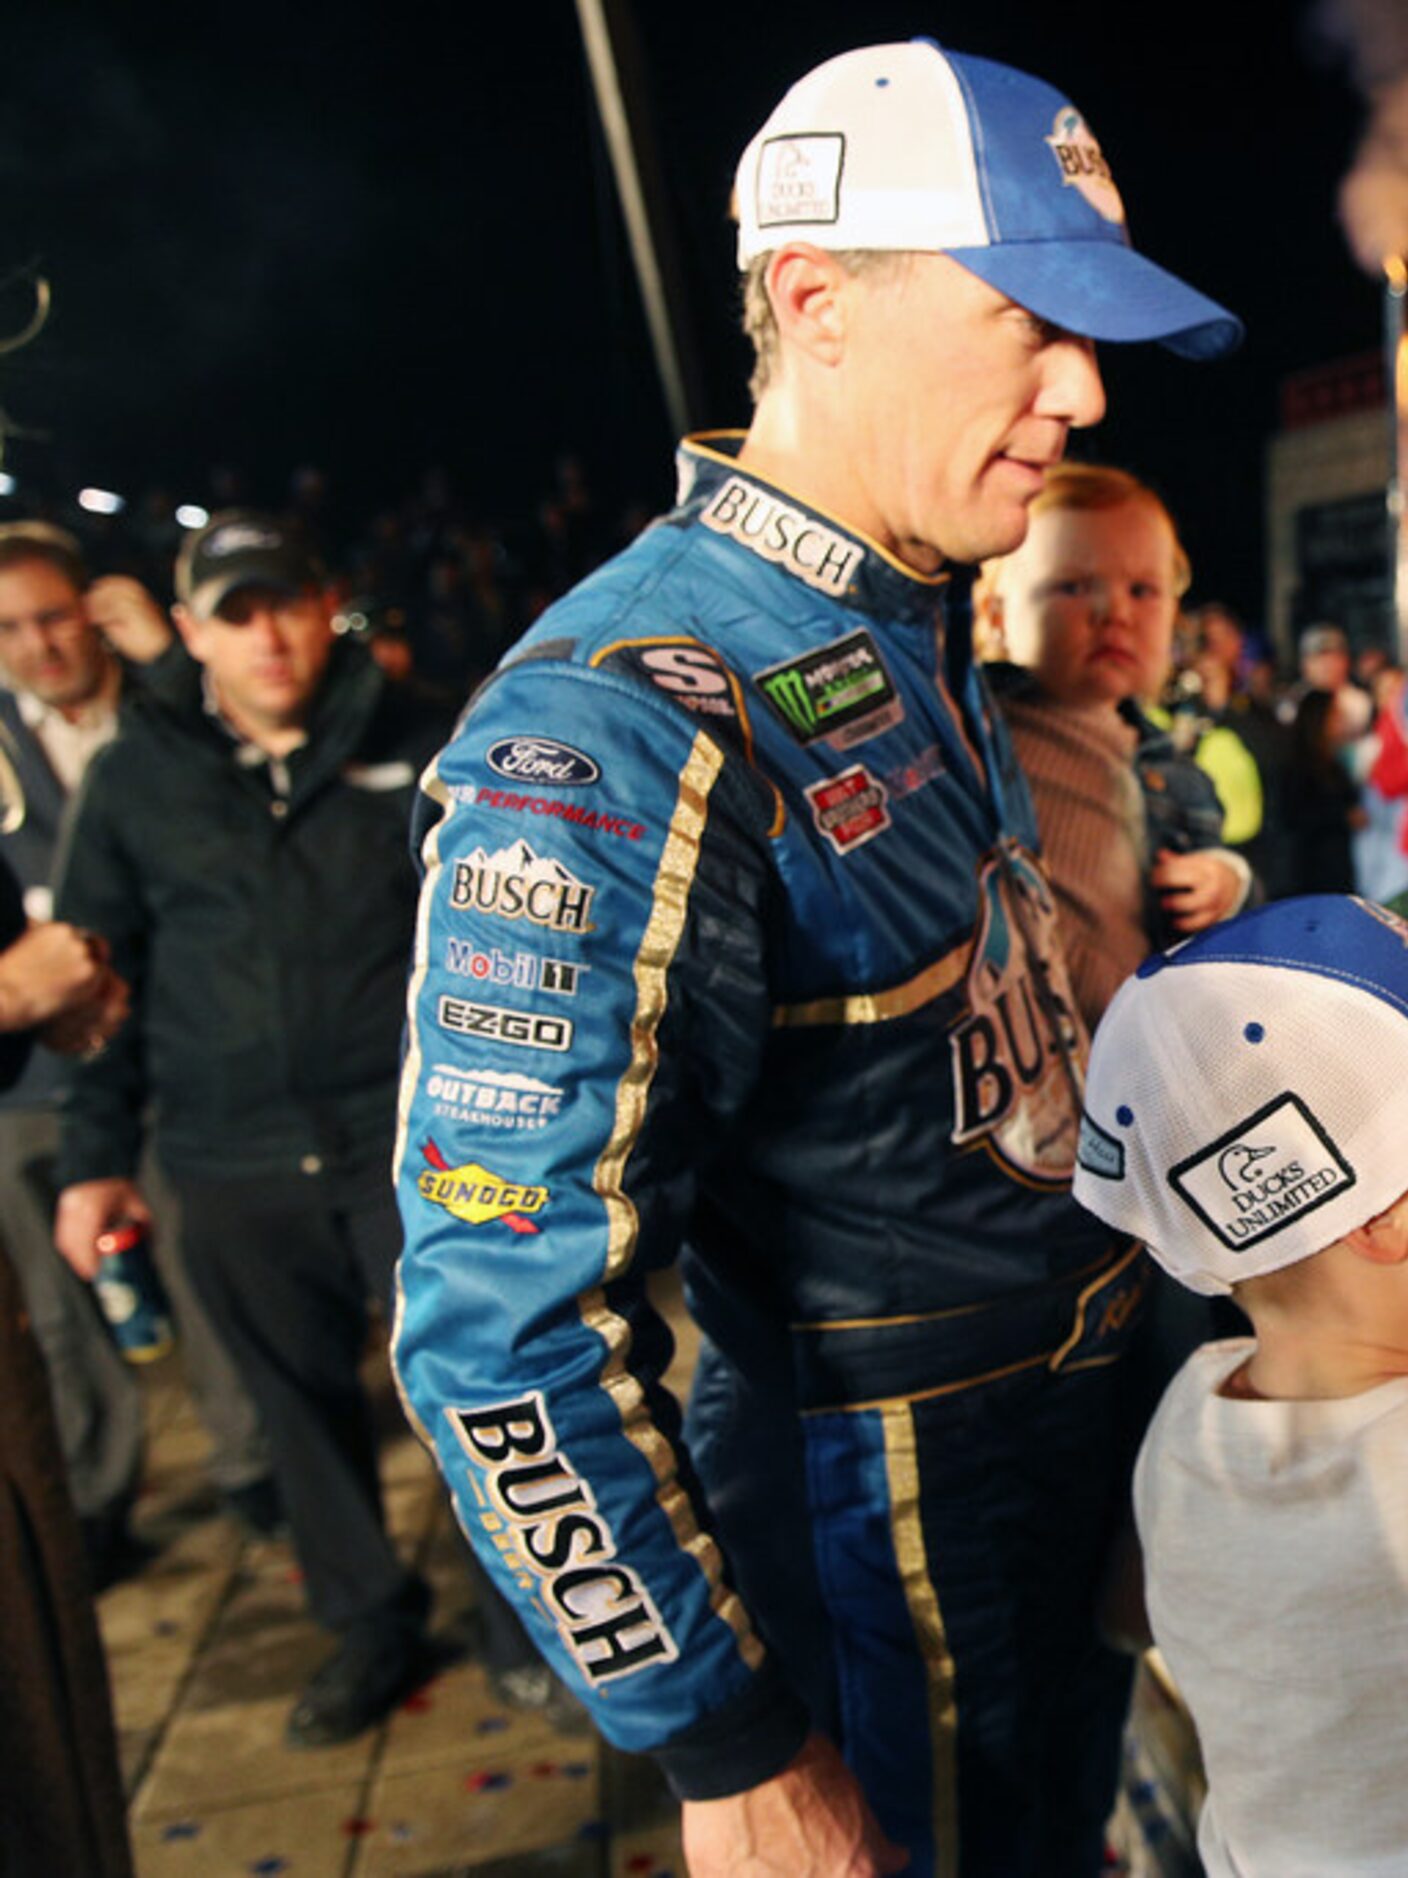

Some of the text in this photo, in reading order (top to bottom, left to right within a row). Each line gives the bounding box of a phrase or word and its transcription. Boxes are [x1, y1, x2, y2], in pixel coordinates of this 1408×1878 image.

[711, 482, 855, 586] BUSCH
[501, 743, 579, 780] Ford
[474, 786, 649, 843] PERFORMANCE
[452, 861, 589, 929] BUSCH
[447, 939, 537, 989] Mobil
[426, 1076, 562, 1115] OUTBACK
[420, 1173, 541, 1209] SUNOCO
[1226, 1167, 1338, 1240] UNLIMITED
[1231, 1160, 1306, 1214] DUCKS
[457, 1395, 670, 1679] BUSCH
